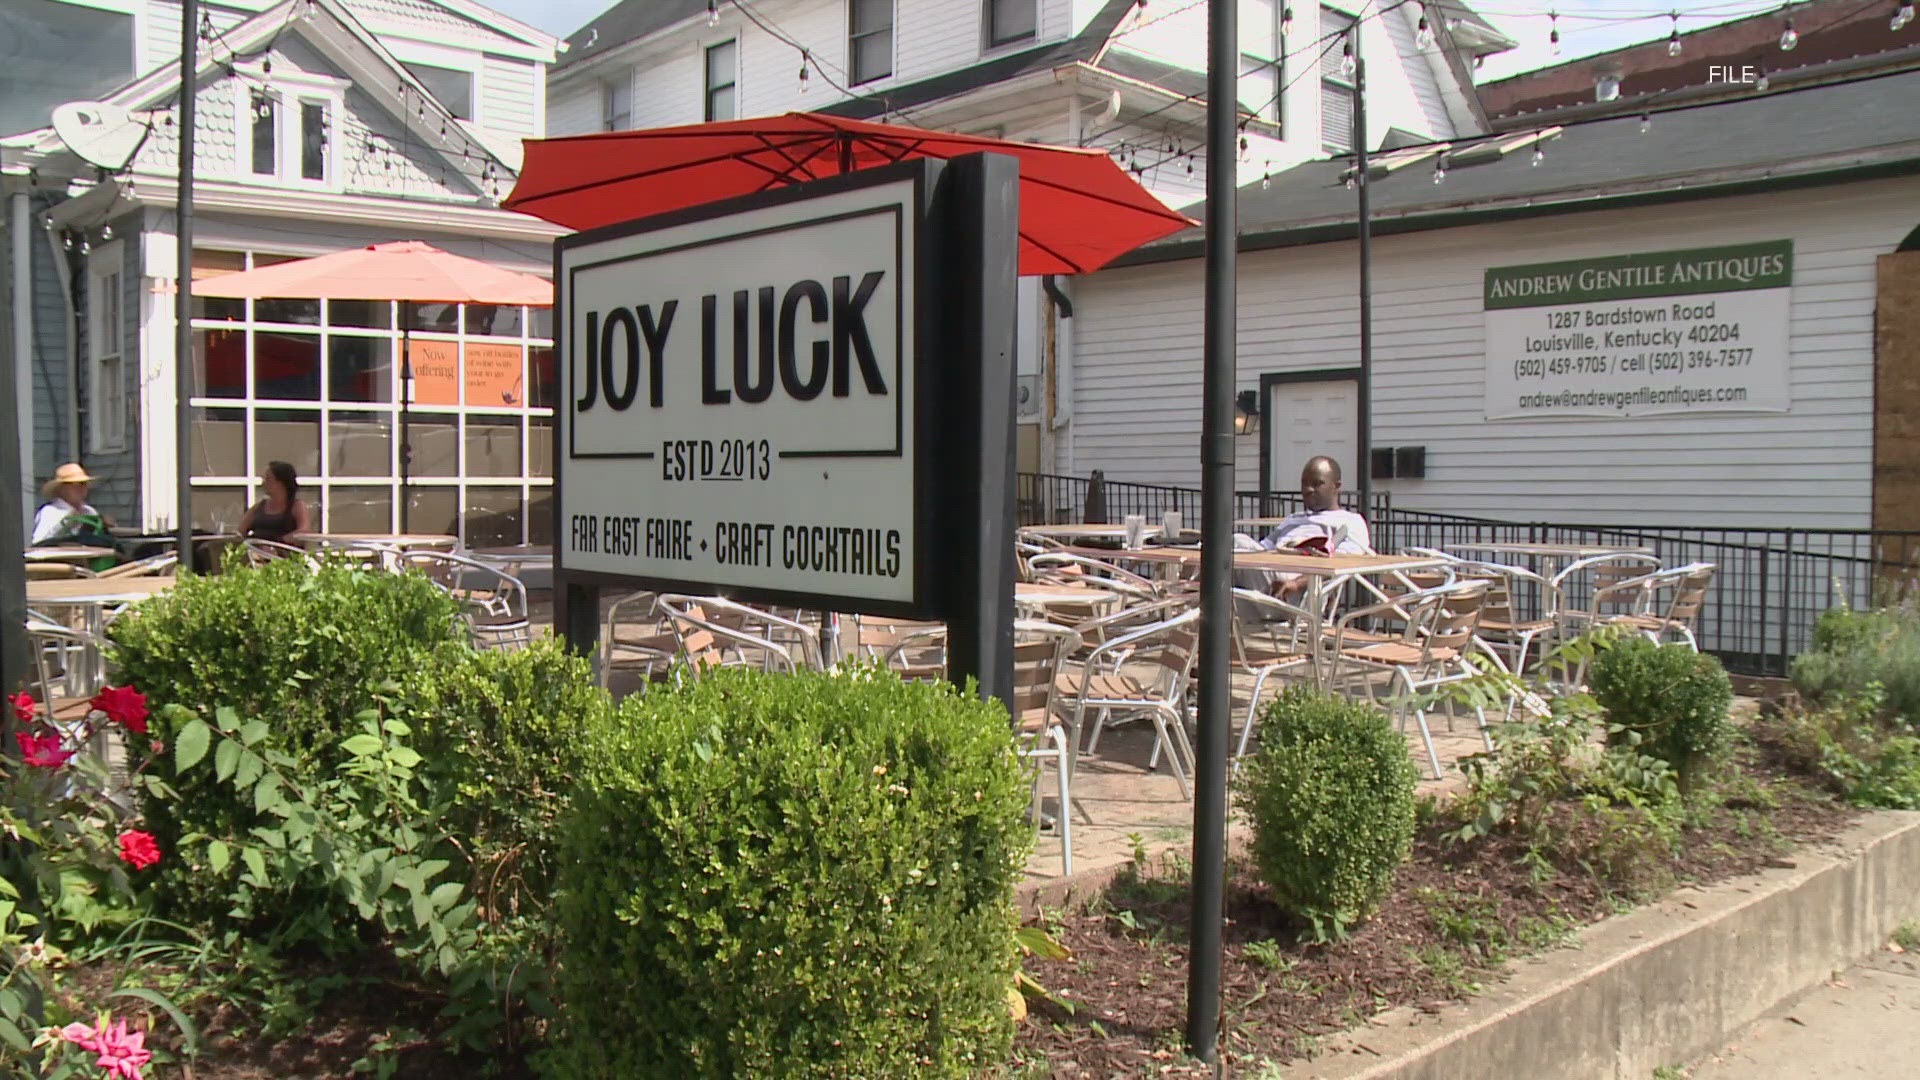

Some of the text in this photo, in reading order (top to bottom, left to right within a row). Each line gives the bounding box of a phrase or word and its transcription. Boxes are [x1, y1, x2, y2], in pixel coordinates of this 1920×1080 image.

[1490, 253, 1785, 299] ANDREW GENTILE ANTIQUES
[1547, 301, 1716, 330] 1287 Bardstown Road
[577, 270, 888, 412] JOY LUCK
[1526, 323, 1740, 353] Louisville, Kentucky 40204
[423, 348, 446, 361] Now
[1514, 359, 1546, 381] (502)
[1549, 355, 1607, 375] 459-9705
[1620, 353, 1646, 372] cell
[1648, 352, 1684, 374] (502)
[1687, 348, 1754, 369] 396-7577
[415, 363, 455, 379] offering
[1519, 387, 1747, 409] andrew@andrewgentileantiques.com
[663, 439, 770, 481] ESTD 2013
[572, 514, 901, 578] FAR EAST FAIRE CRAFT COCKTAILS
